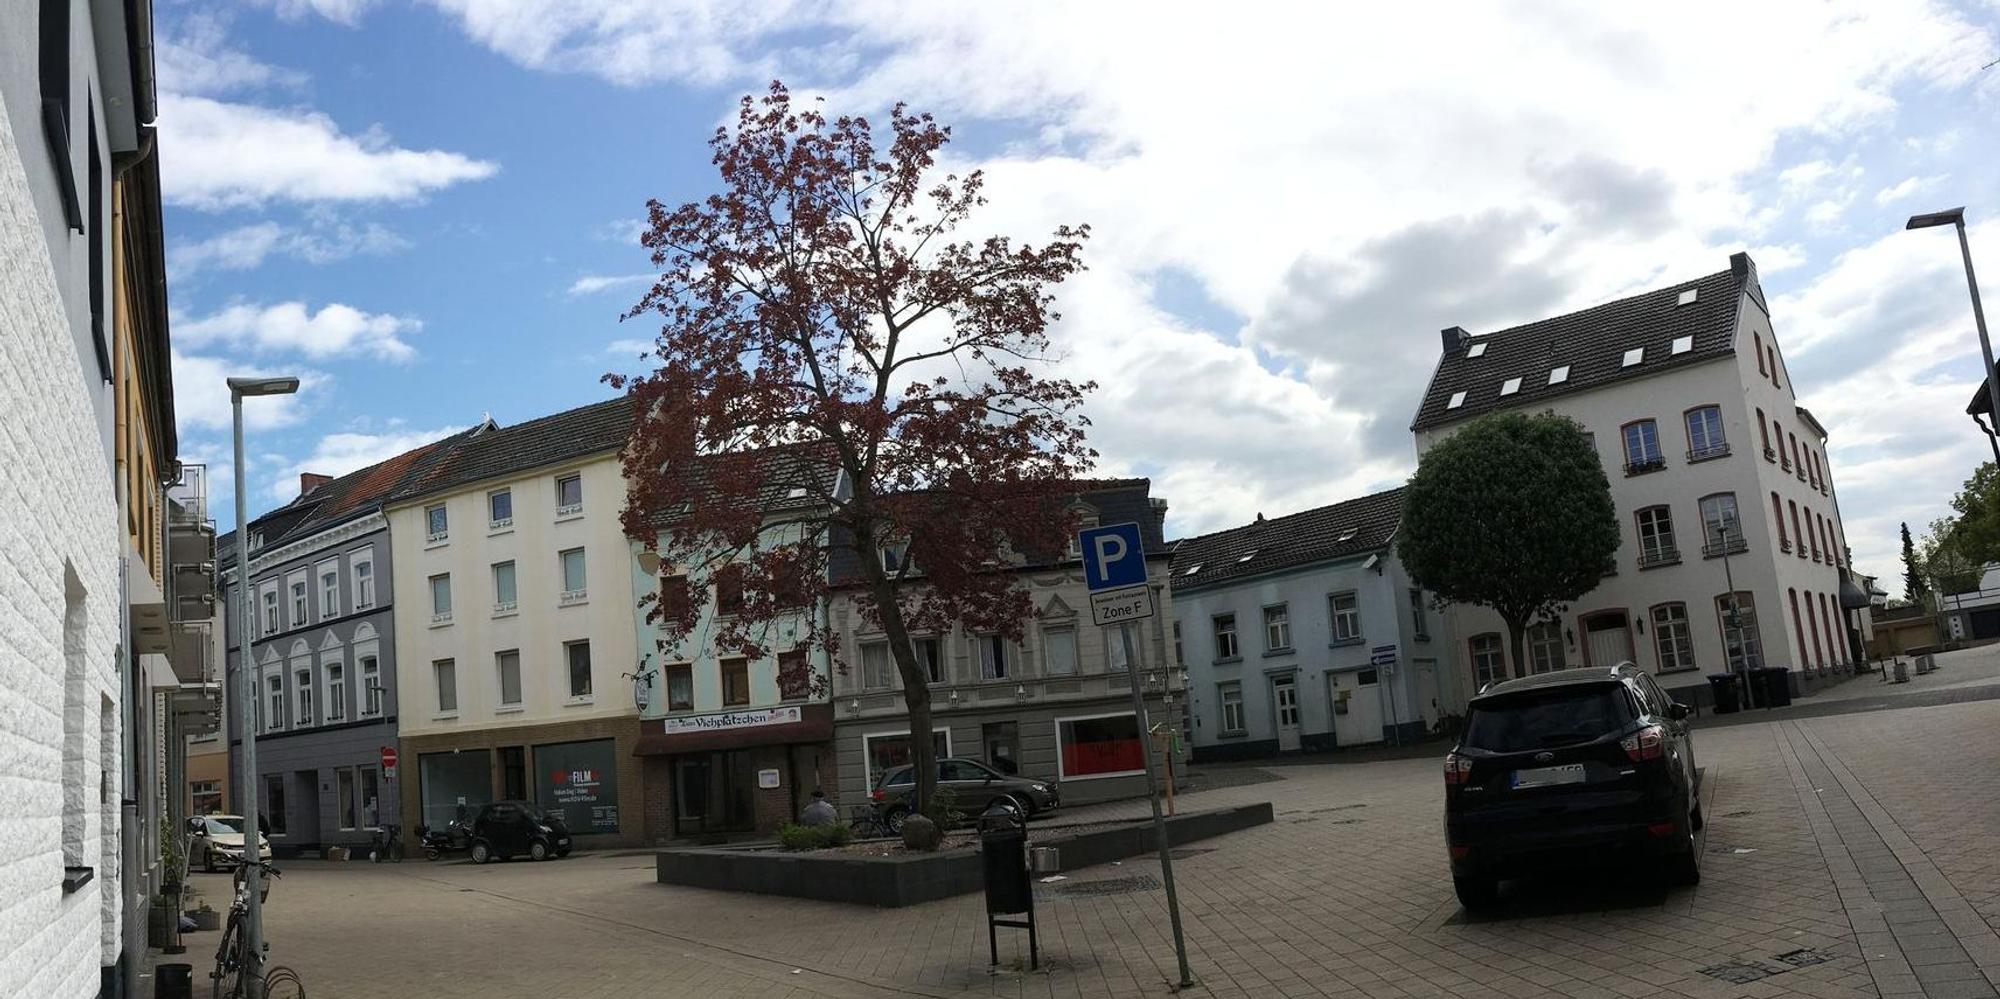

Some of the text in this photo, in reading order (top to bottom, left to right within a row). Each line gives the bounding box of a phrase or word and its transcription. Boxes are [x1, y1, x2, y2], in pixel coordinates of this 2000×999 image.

[1094, 534, 1127, 581] P
[1103, 601, 1142, 619] Zone F
